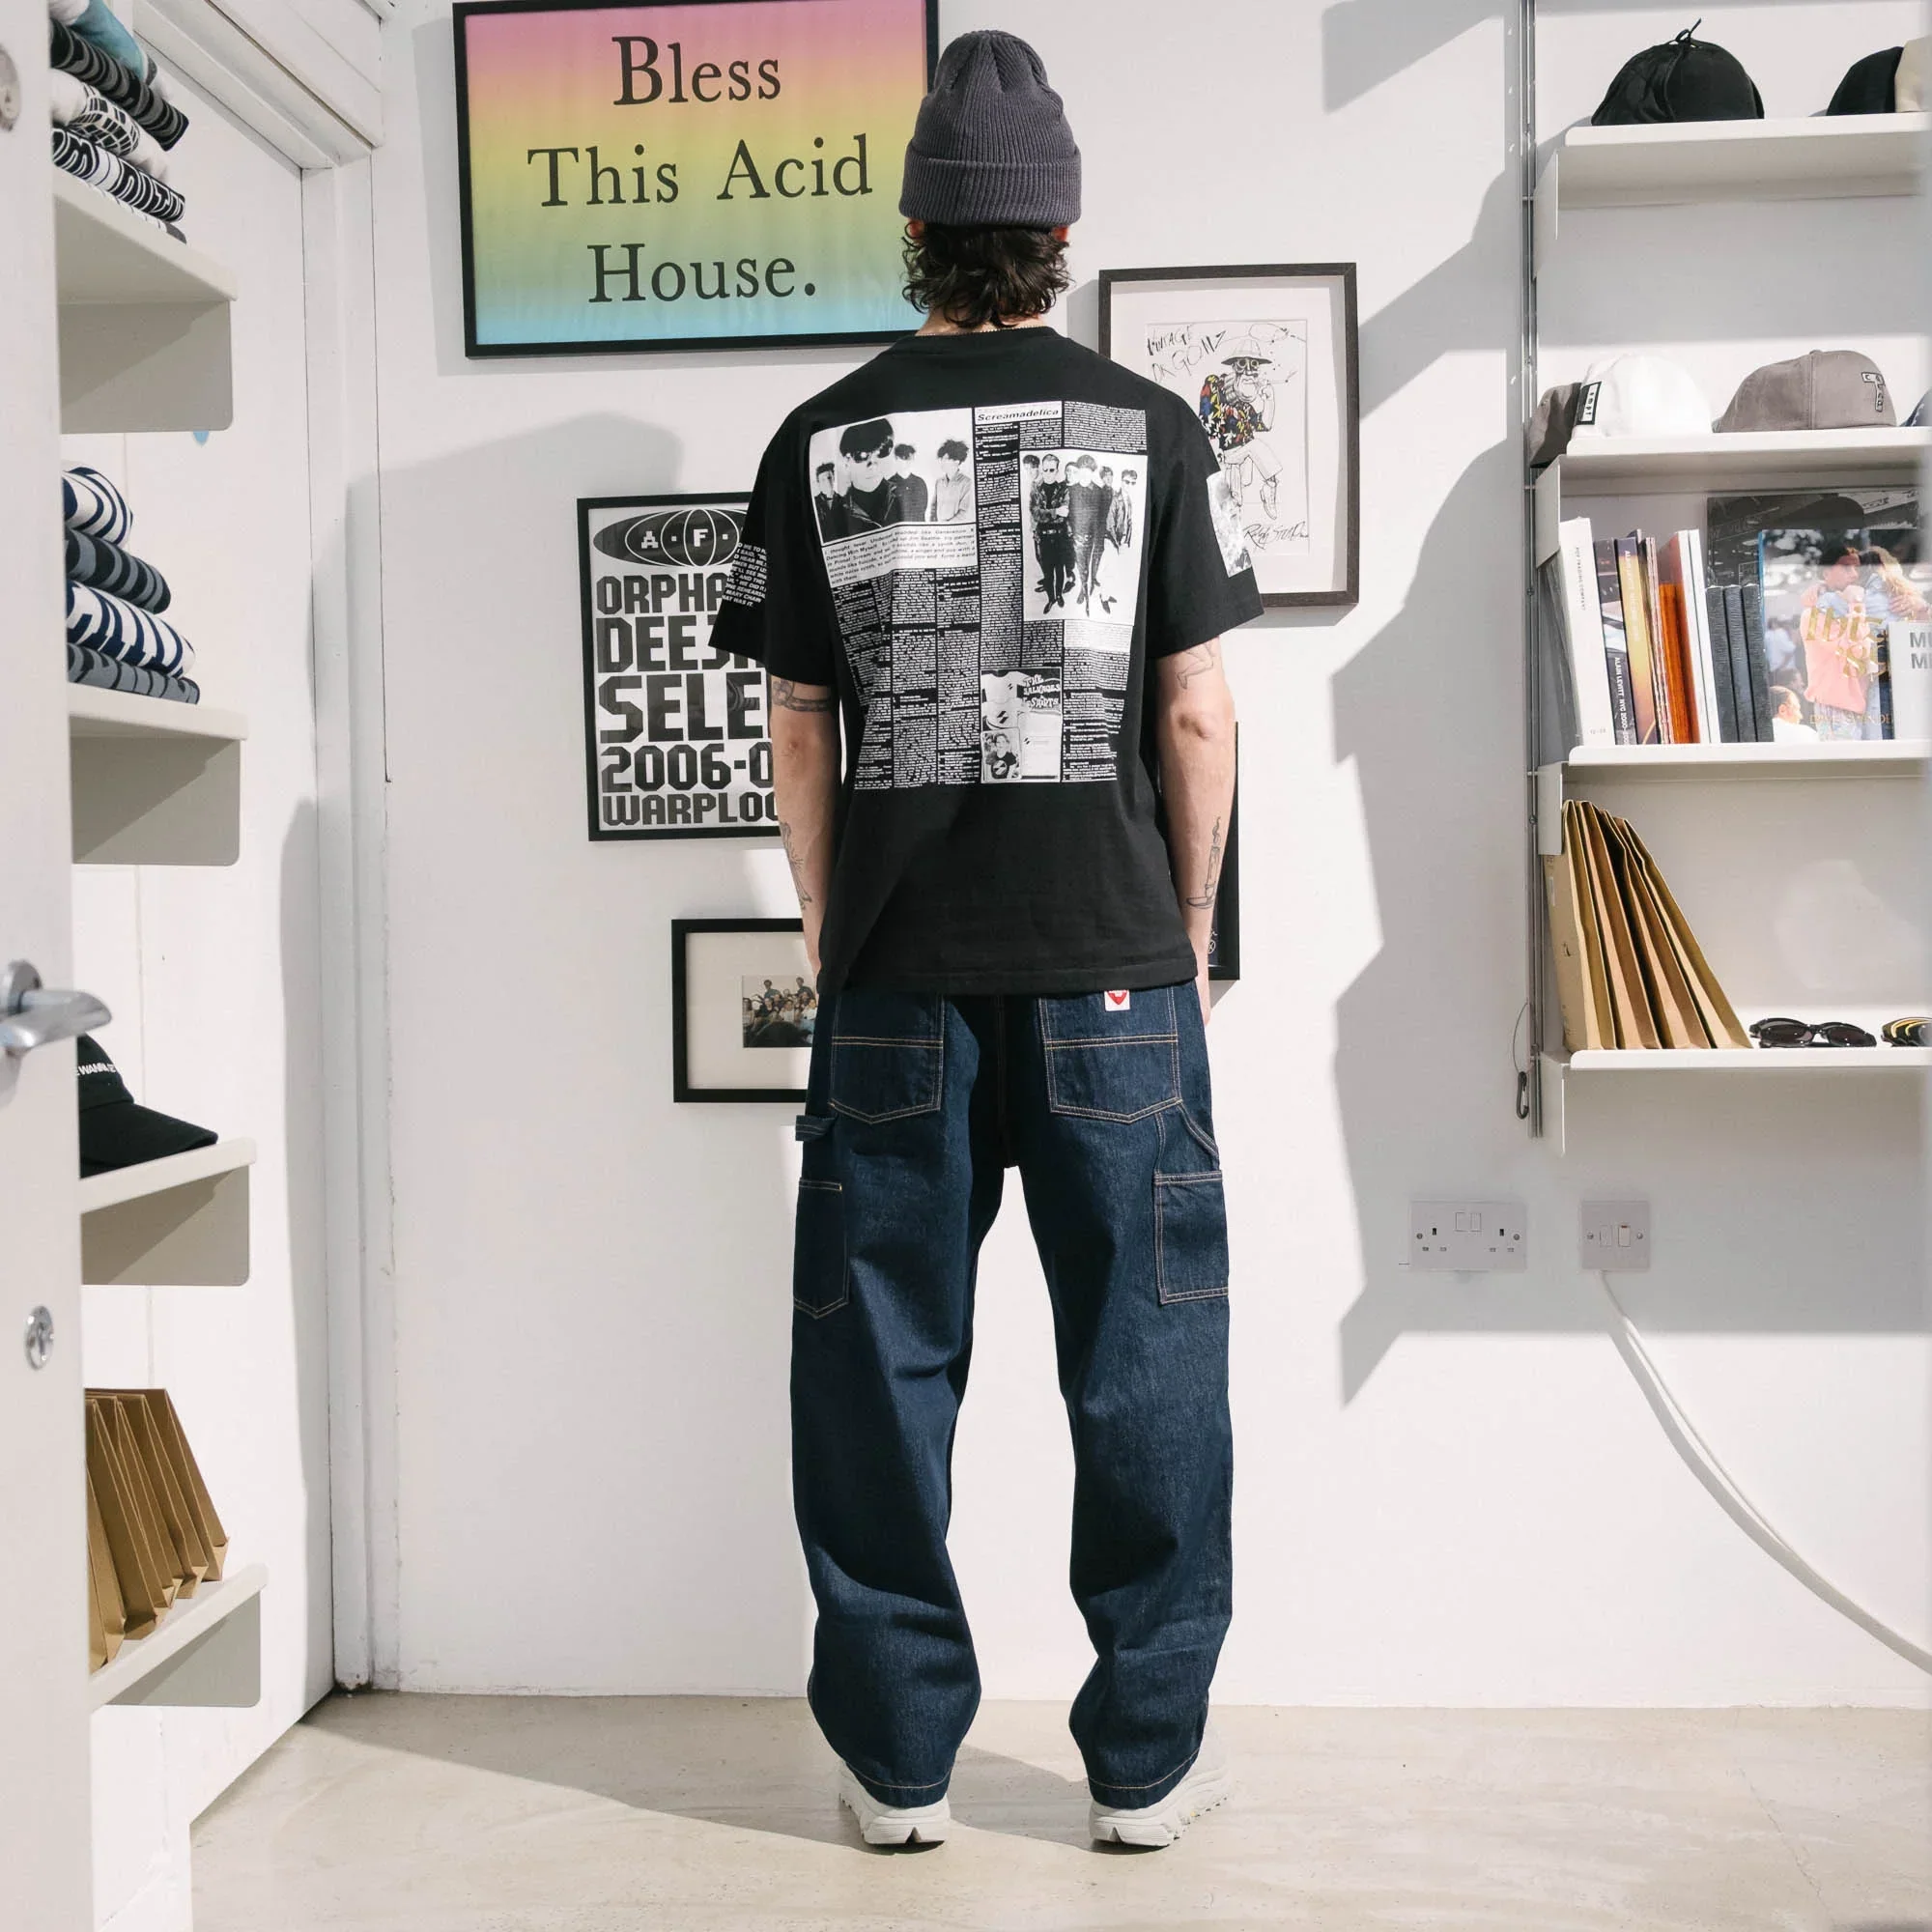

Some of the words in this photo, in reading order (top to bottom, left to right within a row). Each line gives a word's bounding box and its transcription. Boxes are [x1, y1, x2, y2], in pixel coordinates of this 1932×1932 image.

[612, 36, 781, 105] Bless
[527, 144, 679, 207] This
[717, 133, 873, 200] Acid
[587, 243, 816, 303] House.
[978, 409, 1059, 421] Screamadelica
[596, 573, 728, 615] ORPHA
[1614, 657, 1623, 675] ALAIN
[1616, 676, 1625, 696] LEVITT
[599, 671, 771, 743] SELE
[601, 742, 773, 792] 2006-0
